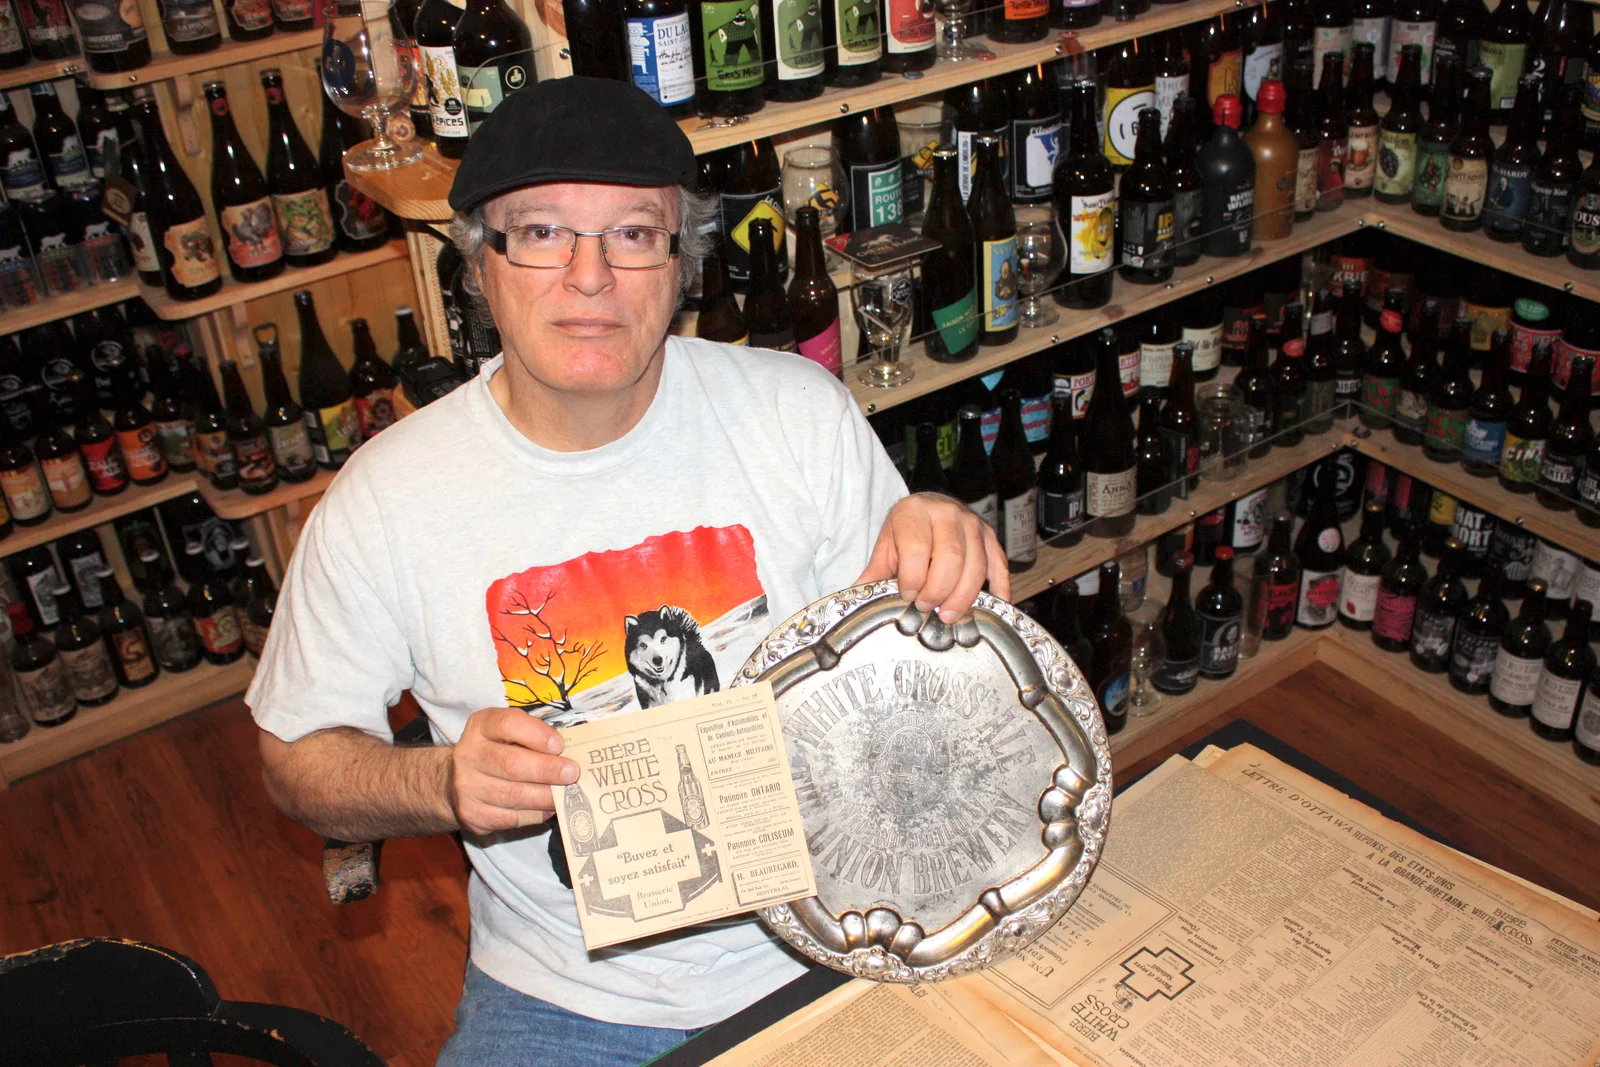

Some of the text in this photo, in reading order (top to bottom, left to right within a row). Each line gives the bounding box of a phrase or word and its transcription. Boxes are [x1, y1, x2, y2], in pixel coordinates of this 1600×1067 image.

[658, 27, 674, 40] DU
[782, 659, 1037, 775] WHITE CROSS ALE
[587, 737, 652, 766] BIERE
[707, 756, 716, 766] AU
[588, 754, 661, 789] WHITE
[598, 779, 669, 815] CROSS
[718, 782, 782, 805] Patinoire ONTARIO
[726, 828, 795, 852] Patinoire COLISEUM
[805, 822, 902, 895] UNION
[912, 790, 1038, 897] BREWERY
[616, 843, 675, 866] "Buvez et
[1351, 829, 1456, 892] REPONSE DES ETATS-UNIS
[608, 854, 691, 887] soyez satisfait"
[750, 860, 801, 879] BEAUREGARD,
[637, 885, 674, 901] Brasserie
[1366, 851, 1470, 912] A LA GRANDE-BRETAGNE
[643, 896, 673, 909] Union.
[1471, 906, 1534, 946] WHITE CROSS
[1492, 907, 1528, 929] BIERE
[1069, 929, 1082, 940] 25
[1550, 937, 1580, 955] PETITES
[1186, 937, 1226, 965] Les assurances
[1402, 943, 1418, 956] ligue
[1544, 943, 1580, 965] SITUATIONS
[1028, 960, 1055, 978] UNE
[1132, 960, 1151, 975] soyez
[1424, 956, 1441, 970] Dans
[1070, 1001, 1120, 1043] WHITE
[1084, 994, 1131, 1031] CROSS
[1068, 1017, 1102, 1043] BIERE
